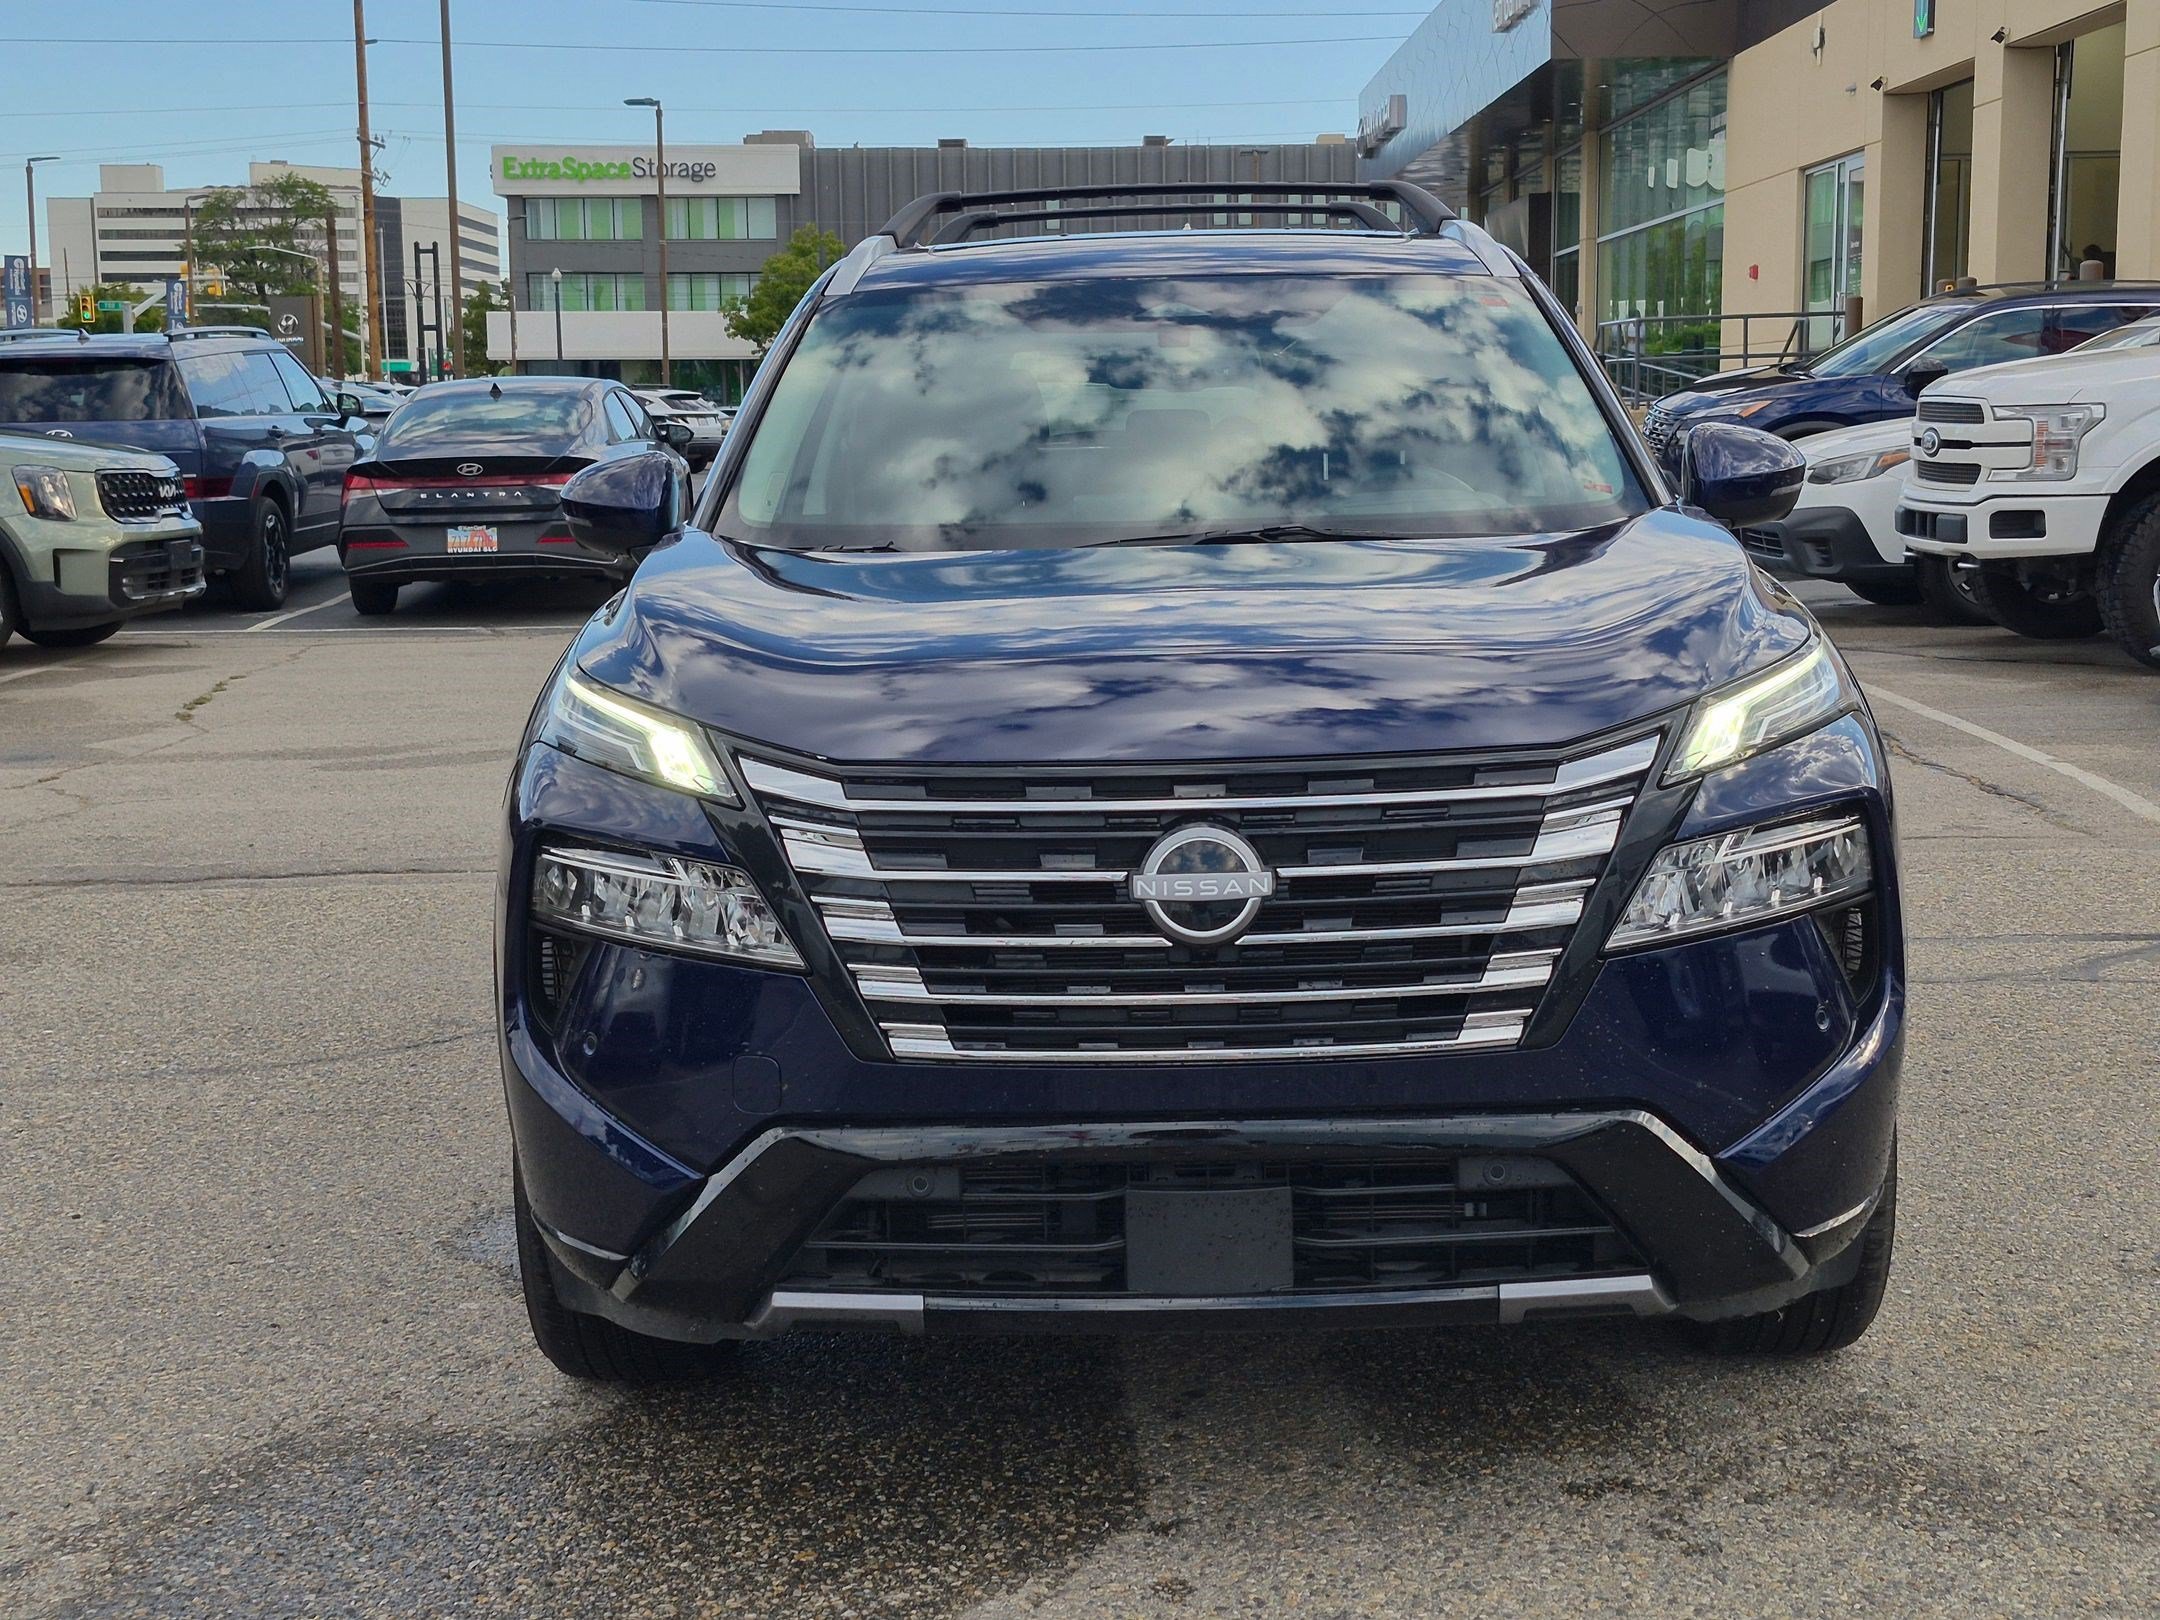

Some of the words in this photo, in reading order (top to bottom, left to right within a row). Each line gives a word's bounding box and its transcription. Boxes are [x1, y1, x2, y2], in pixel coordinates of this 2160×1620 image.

[502, 156, 631, 182] ExtraSpace
[420, 490, 522, 499] ELANTRA
[1135, 877, 1270, 896] NISSAN
